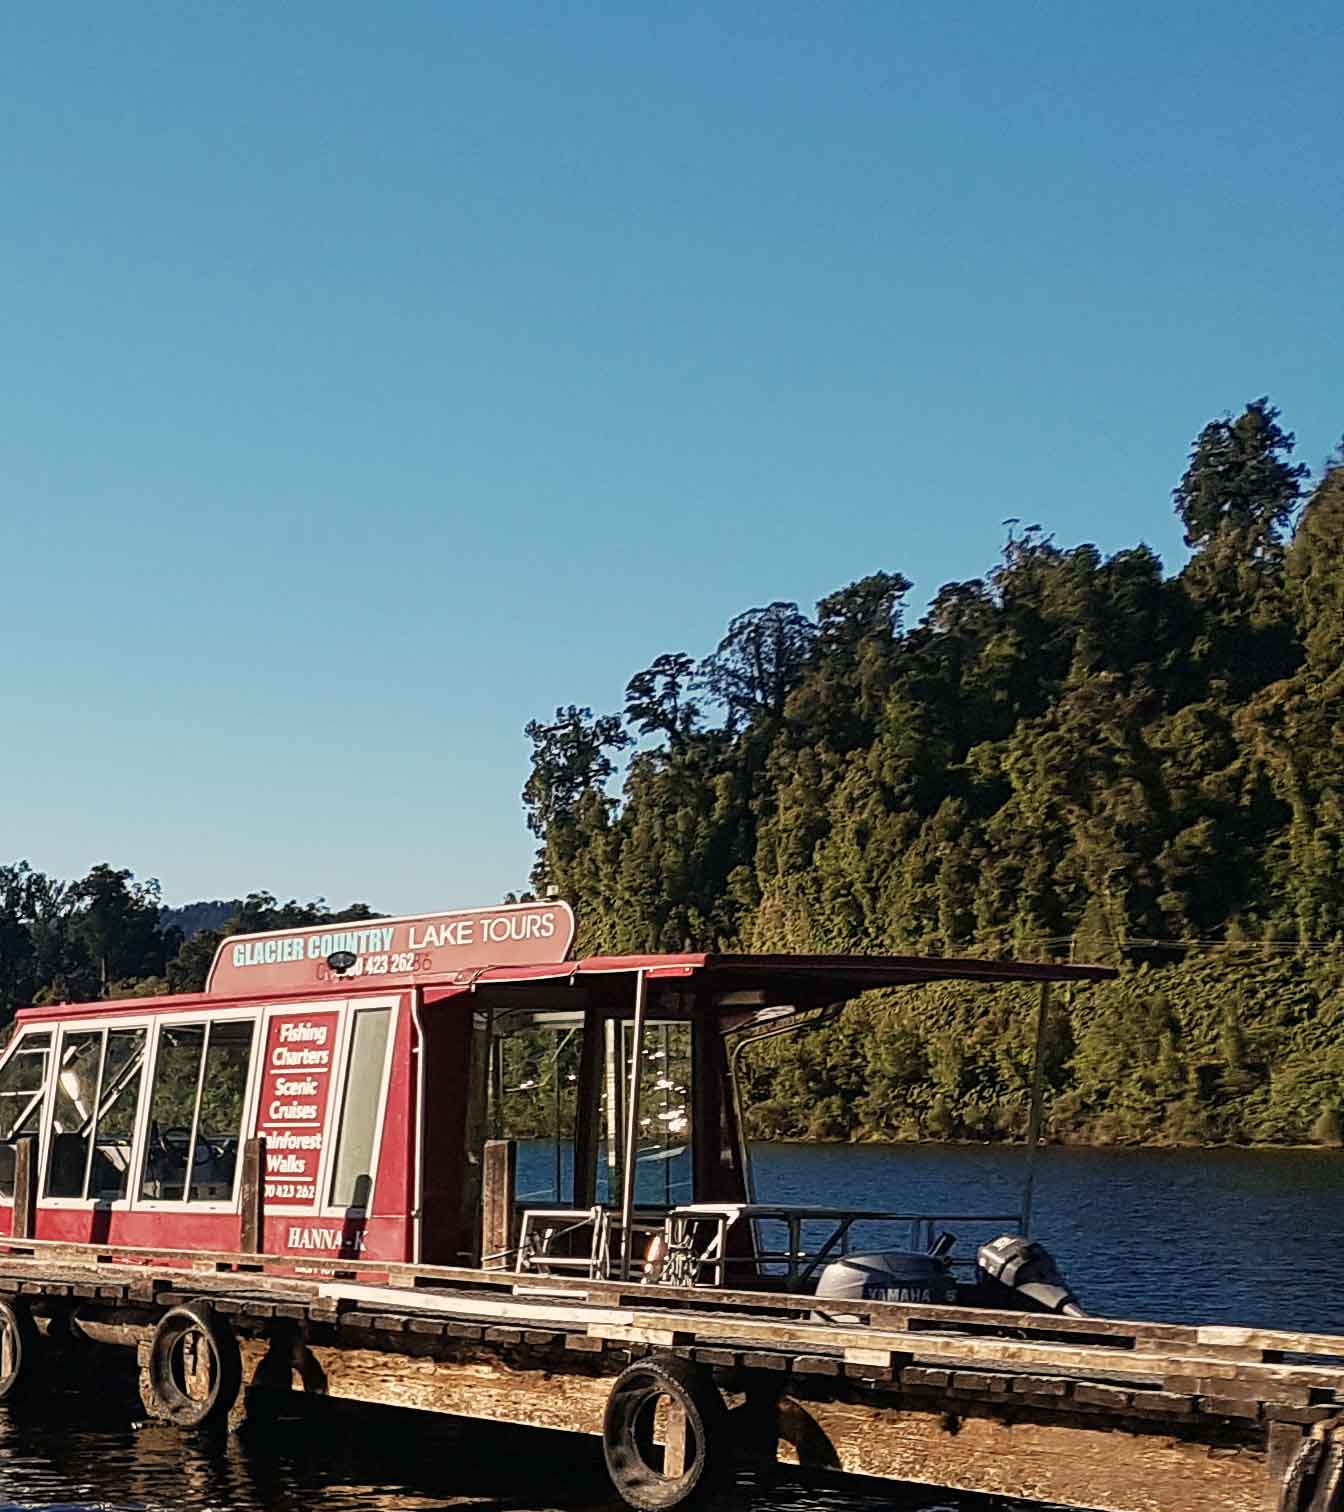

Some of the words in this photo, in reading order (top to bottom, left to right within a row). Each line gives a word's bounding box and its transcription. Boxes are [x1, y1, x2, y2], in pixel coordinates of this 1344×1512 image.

[233, 938, 304, 967] GLACIER
[307, 928, 394, 959] COUNTRY
[409, 921, 474, 949] LAKE
[480, 913, 554, 942] TOURS
[365, 955, 388, 974] 423
[391, 952, 414, 972] 262
[279, 1022, 328, 1045] Fishing
[272, 1047, 329, 1065] Charters
[275, 1076, 318, 1096] Scenic
[269, 1101, 318, 1119] Cruises
[266, 1154, 305, 1173] Walks
[276, 1184, 294, 1198] 423
[296, 1184, 315, 1198] 262
[868, 1287, 931, 1302] YAMAHA
